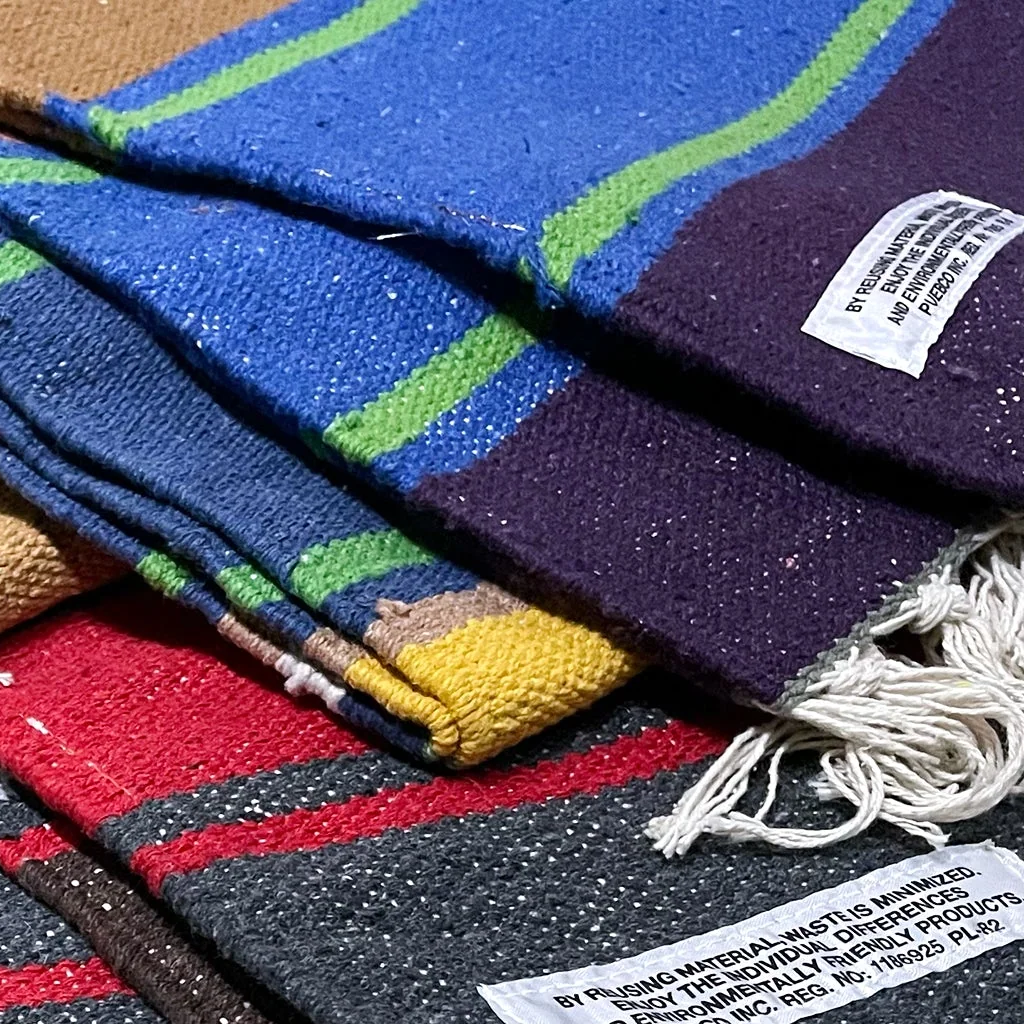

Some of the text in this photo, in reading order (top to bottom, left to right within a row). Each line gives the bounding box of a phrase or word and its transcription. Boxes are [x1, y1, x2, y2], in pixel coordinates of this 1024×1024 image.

[880, 263, 913, 294] ENJOY
[901, 246, 927, 264] THE
[918, 271, 956, 316] PUEBCO
[946, 257, 969, 276] INC.
[845, 296, 867, 313] BY
[887, 301, 910, 326] AND
[553, 993, 584, 1009] BY
[583, 971, 679, 1001] REUSING
[778, 911, 852, 942] WASTE
[846, 903, 874, 920] IS
[870, 866, 983, 910] MINIMIZED.
[611, 886, 970, 1012] ENJOY THE INDIVIDUAL DIFFERENCES
[821, 927, 915, 968] FRIENDLY
[730, 999, 778, 1022] INC.
[778, 983, 835, 1007] REG.
[831, 970, 872, 987] NO:
[870, 939, 945, 973] 1186925
